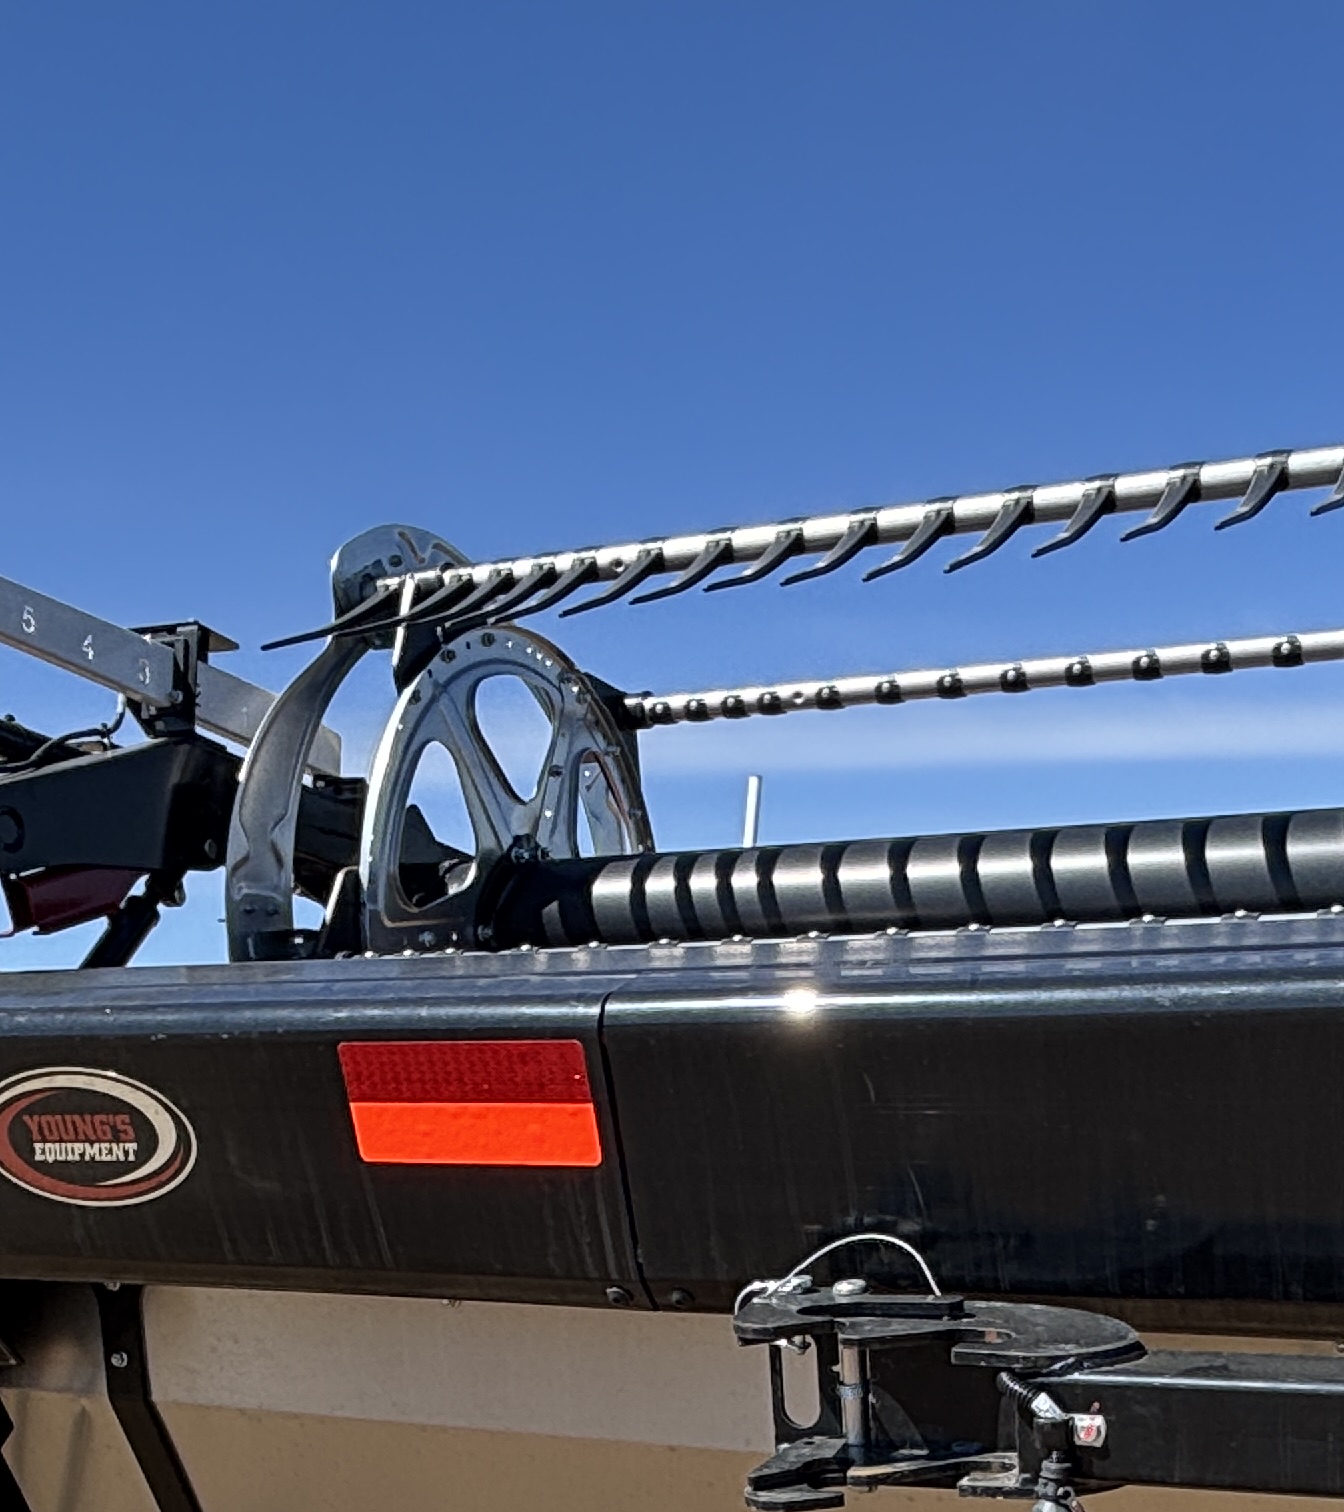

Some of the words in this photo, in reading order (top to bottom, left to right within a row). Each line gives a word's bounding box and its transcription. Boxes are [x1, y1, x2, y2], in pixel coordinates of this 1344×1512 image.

[21, 605, 36, 634] 5
[82, 634, 94, 660] 4
[22, 1114, 136, 1141] YOUNG'S
[33, 1142, 138, 1163] EQUIPMENT
